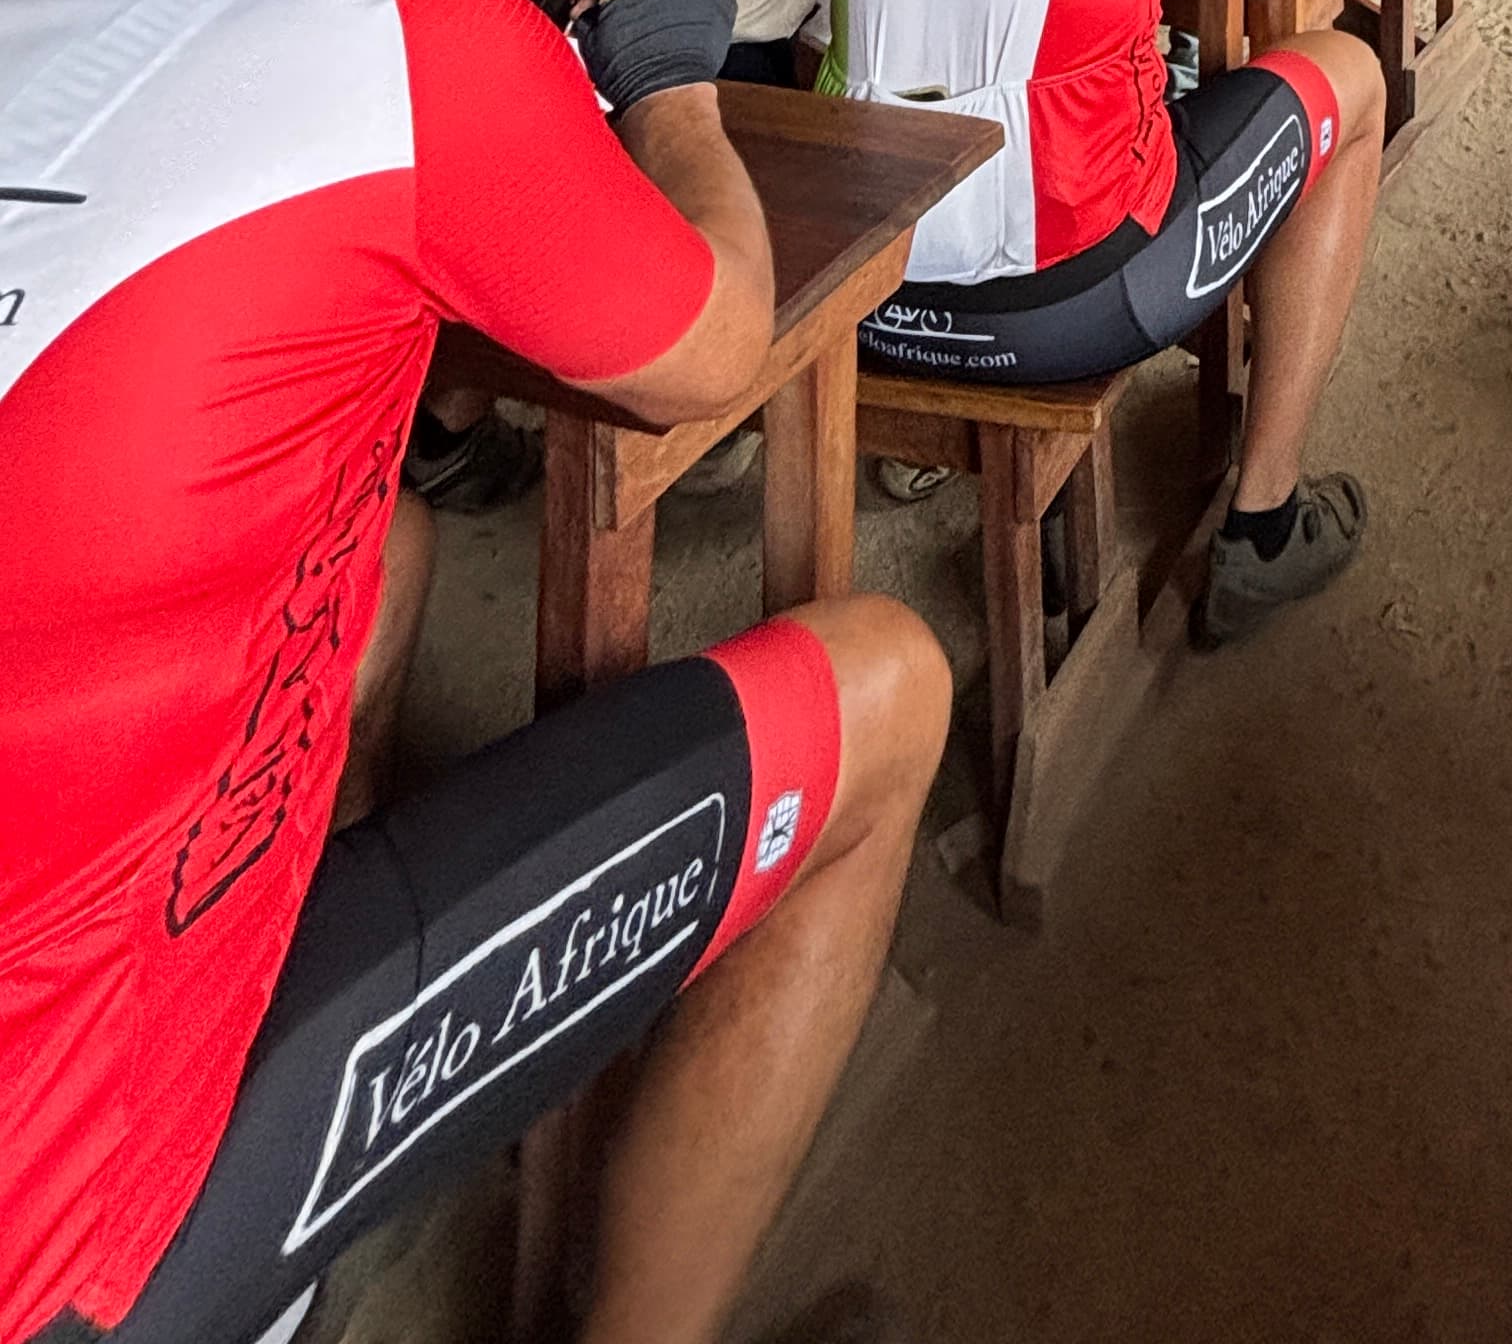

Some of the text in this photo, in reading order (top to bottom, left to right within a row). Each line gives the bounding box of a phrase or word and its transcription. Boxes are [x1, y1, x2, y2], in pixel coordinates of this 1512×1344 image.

[1207, 146, 1299, 265] Vélo Afrique
[859, 330, 1017, 368] eloafrique.com
[364, 858, 703, 1151] Vélo Afrique
